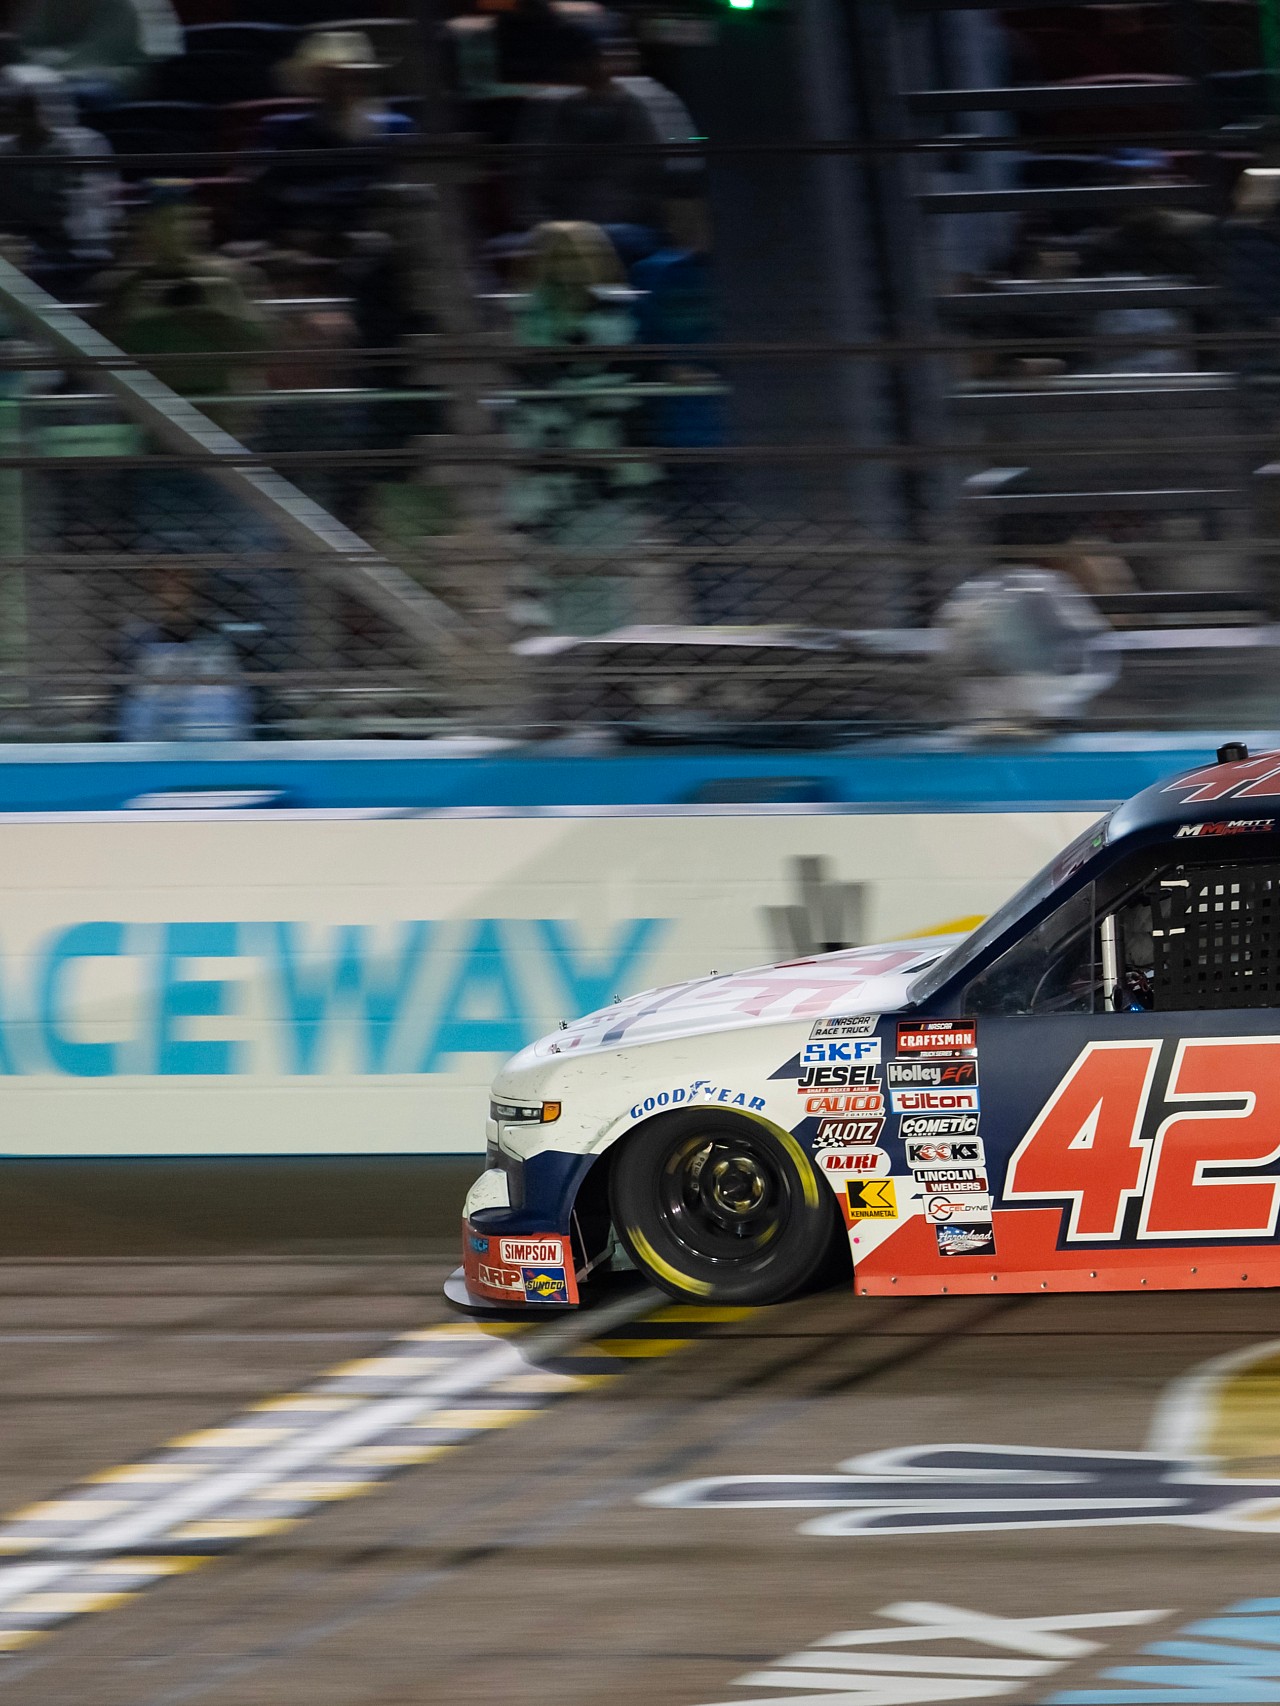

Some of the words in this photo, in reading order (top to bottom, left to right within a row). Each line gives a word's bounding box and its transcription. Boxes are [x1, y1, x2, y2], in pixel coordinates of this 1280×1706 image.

[1227, 819, 1275, 827] MATT
[0, 918, 675, 1077] CEWAY
[834, 1016, 870, 1026] NASCAR
[927, 1022, 953, 1030] NASCAR
[815, 1027, 838, 1036] RACE
[841, 1025, 870, 1034] TRUCK
[900, 1033, 972, 1047] CRAFTSMAN
[803, 1041, 878, 1063] SKF
[798, 1065, 879, 1087] JESEL
[889, 1064, 941, 1085] Holley
[804, 1095, 882, 1114] CALICO
[897, 1093, 974, 1109] tilton
[820, 1121, 876, 1141] KLOTZ
[902, 1114, 977, 1133] COMETIC
[908, 1142, 981, 1162] KOOKS
[825, 1152, 884, 1170] DART
[917, 1170, 974, 1182] LINCOLN
[930, 1182, 981, 1192] WELDERS
[850, 1210, 897, 1218] KENNAMETAL
[927, 1202, 989, 1216] XCELDYNE
[938, 1229, 993, 1243] Arrowhead
[504, 1243, 557, 1261] SIMPSON
[480, 1265, 522, 1287] ARP
[526, 1280, 565, 1291] SUNOCO
